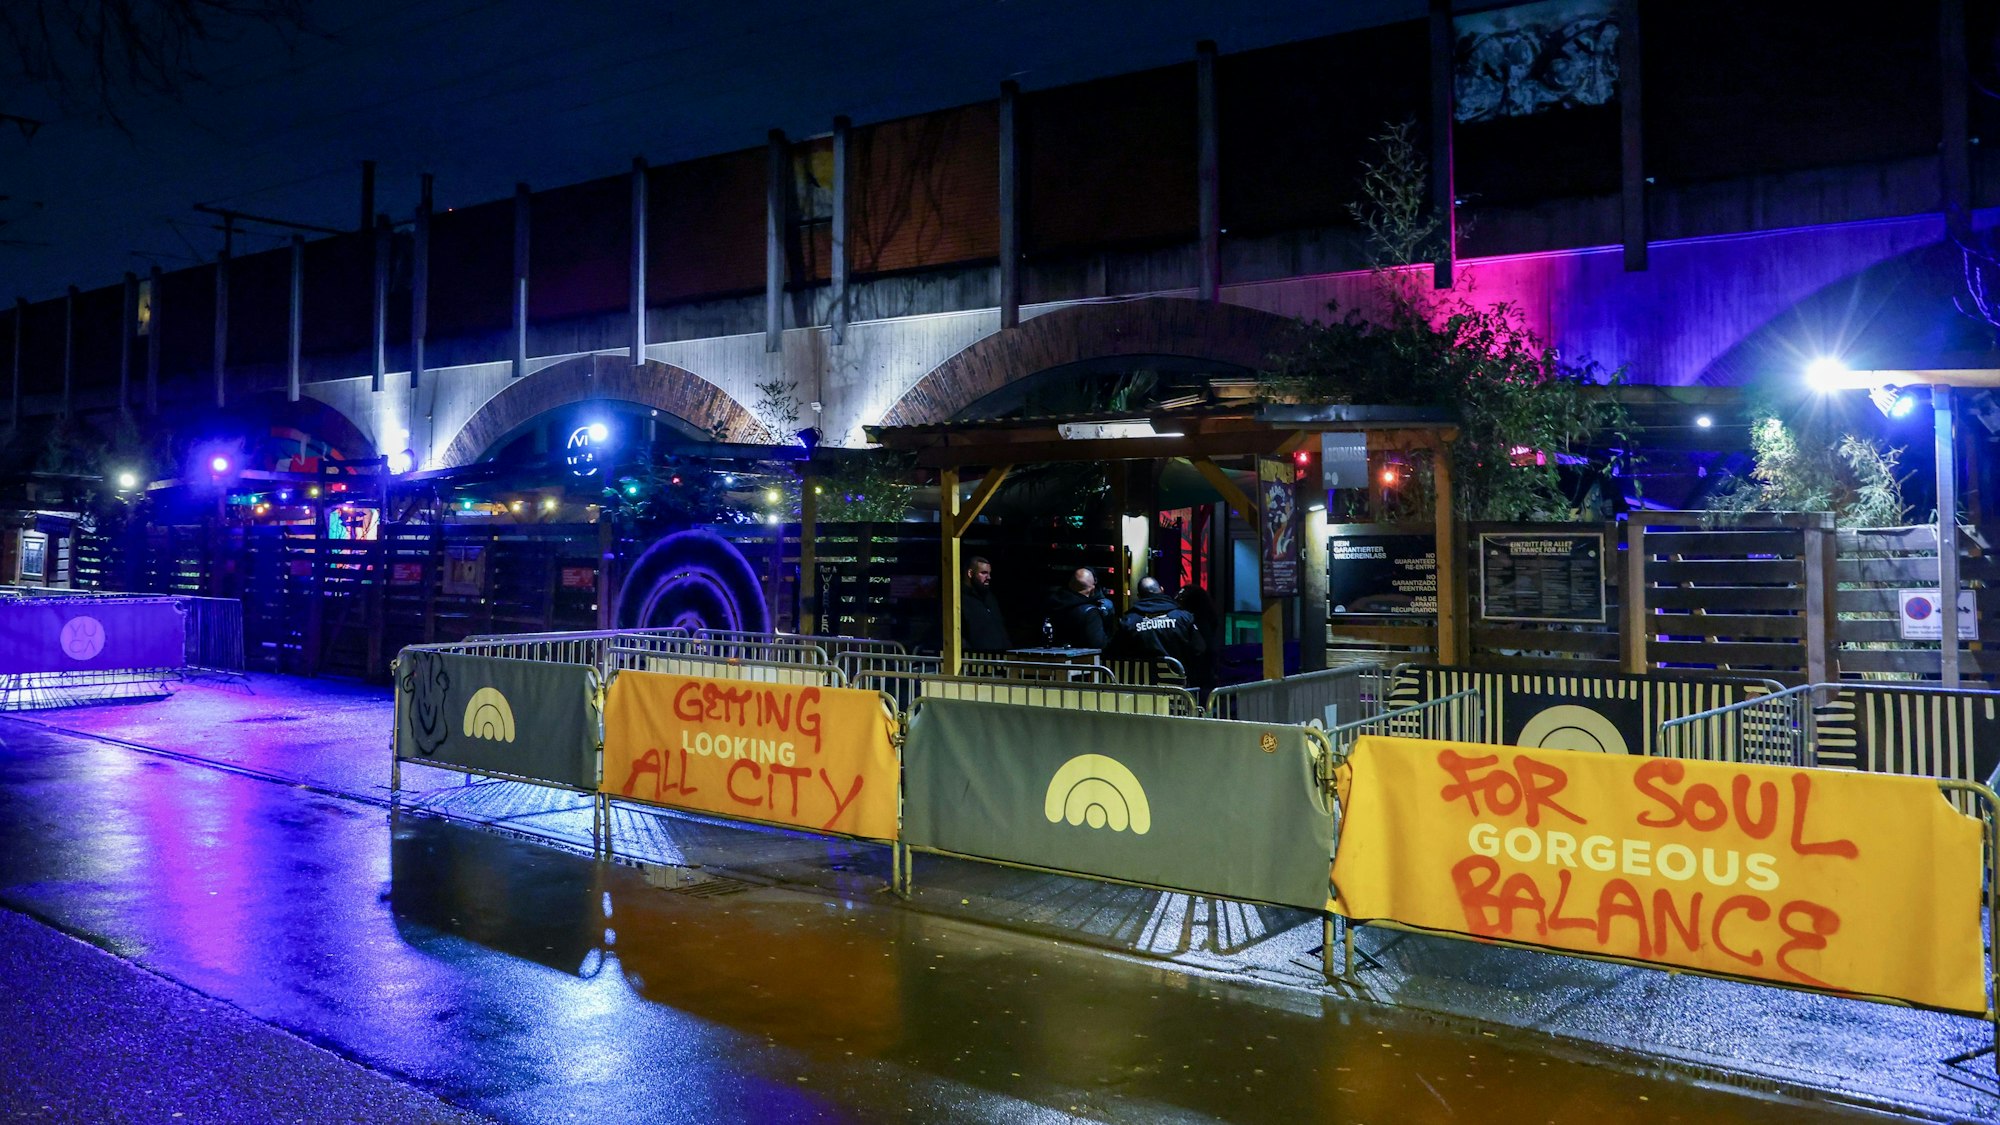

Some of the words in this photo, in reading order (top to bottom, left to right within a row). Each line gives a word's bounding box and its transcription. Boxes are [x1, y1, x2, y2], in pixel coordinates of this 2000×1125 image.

[1333, 552, 1387, 560] WIEDEREINLASS
[1135, 618, 1177, 632] SECURITY
[673, 681, 821, 753] GETTING
[682, 730, 796, 767] LOOKING
[623, 748, 698, 800] ALL
[727, 758, 865, 834] CITY
[1438, 749, 1588, 828] FOR
[1633, 758, 1859, 860] SOUL
[1468, 823, 1781, 892] GORGEOUS
[1451, 854, 1848, 992] BALANCE
